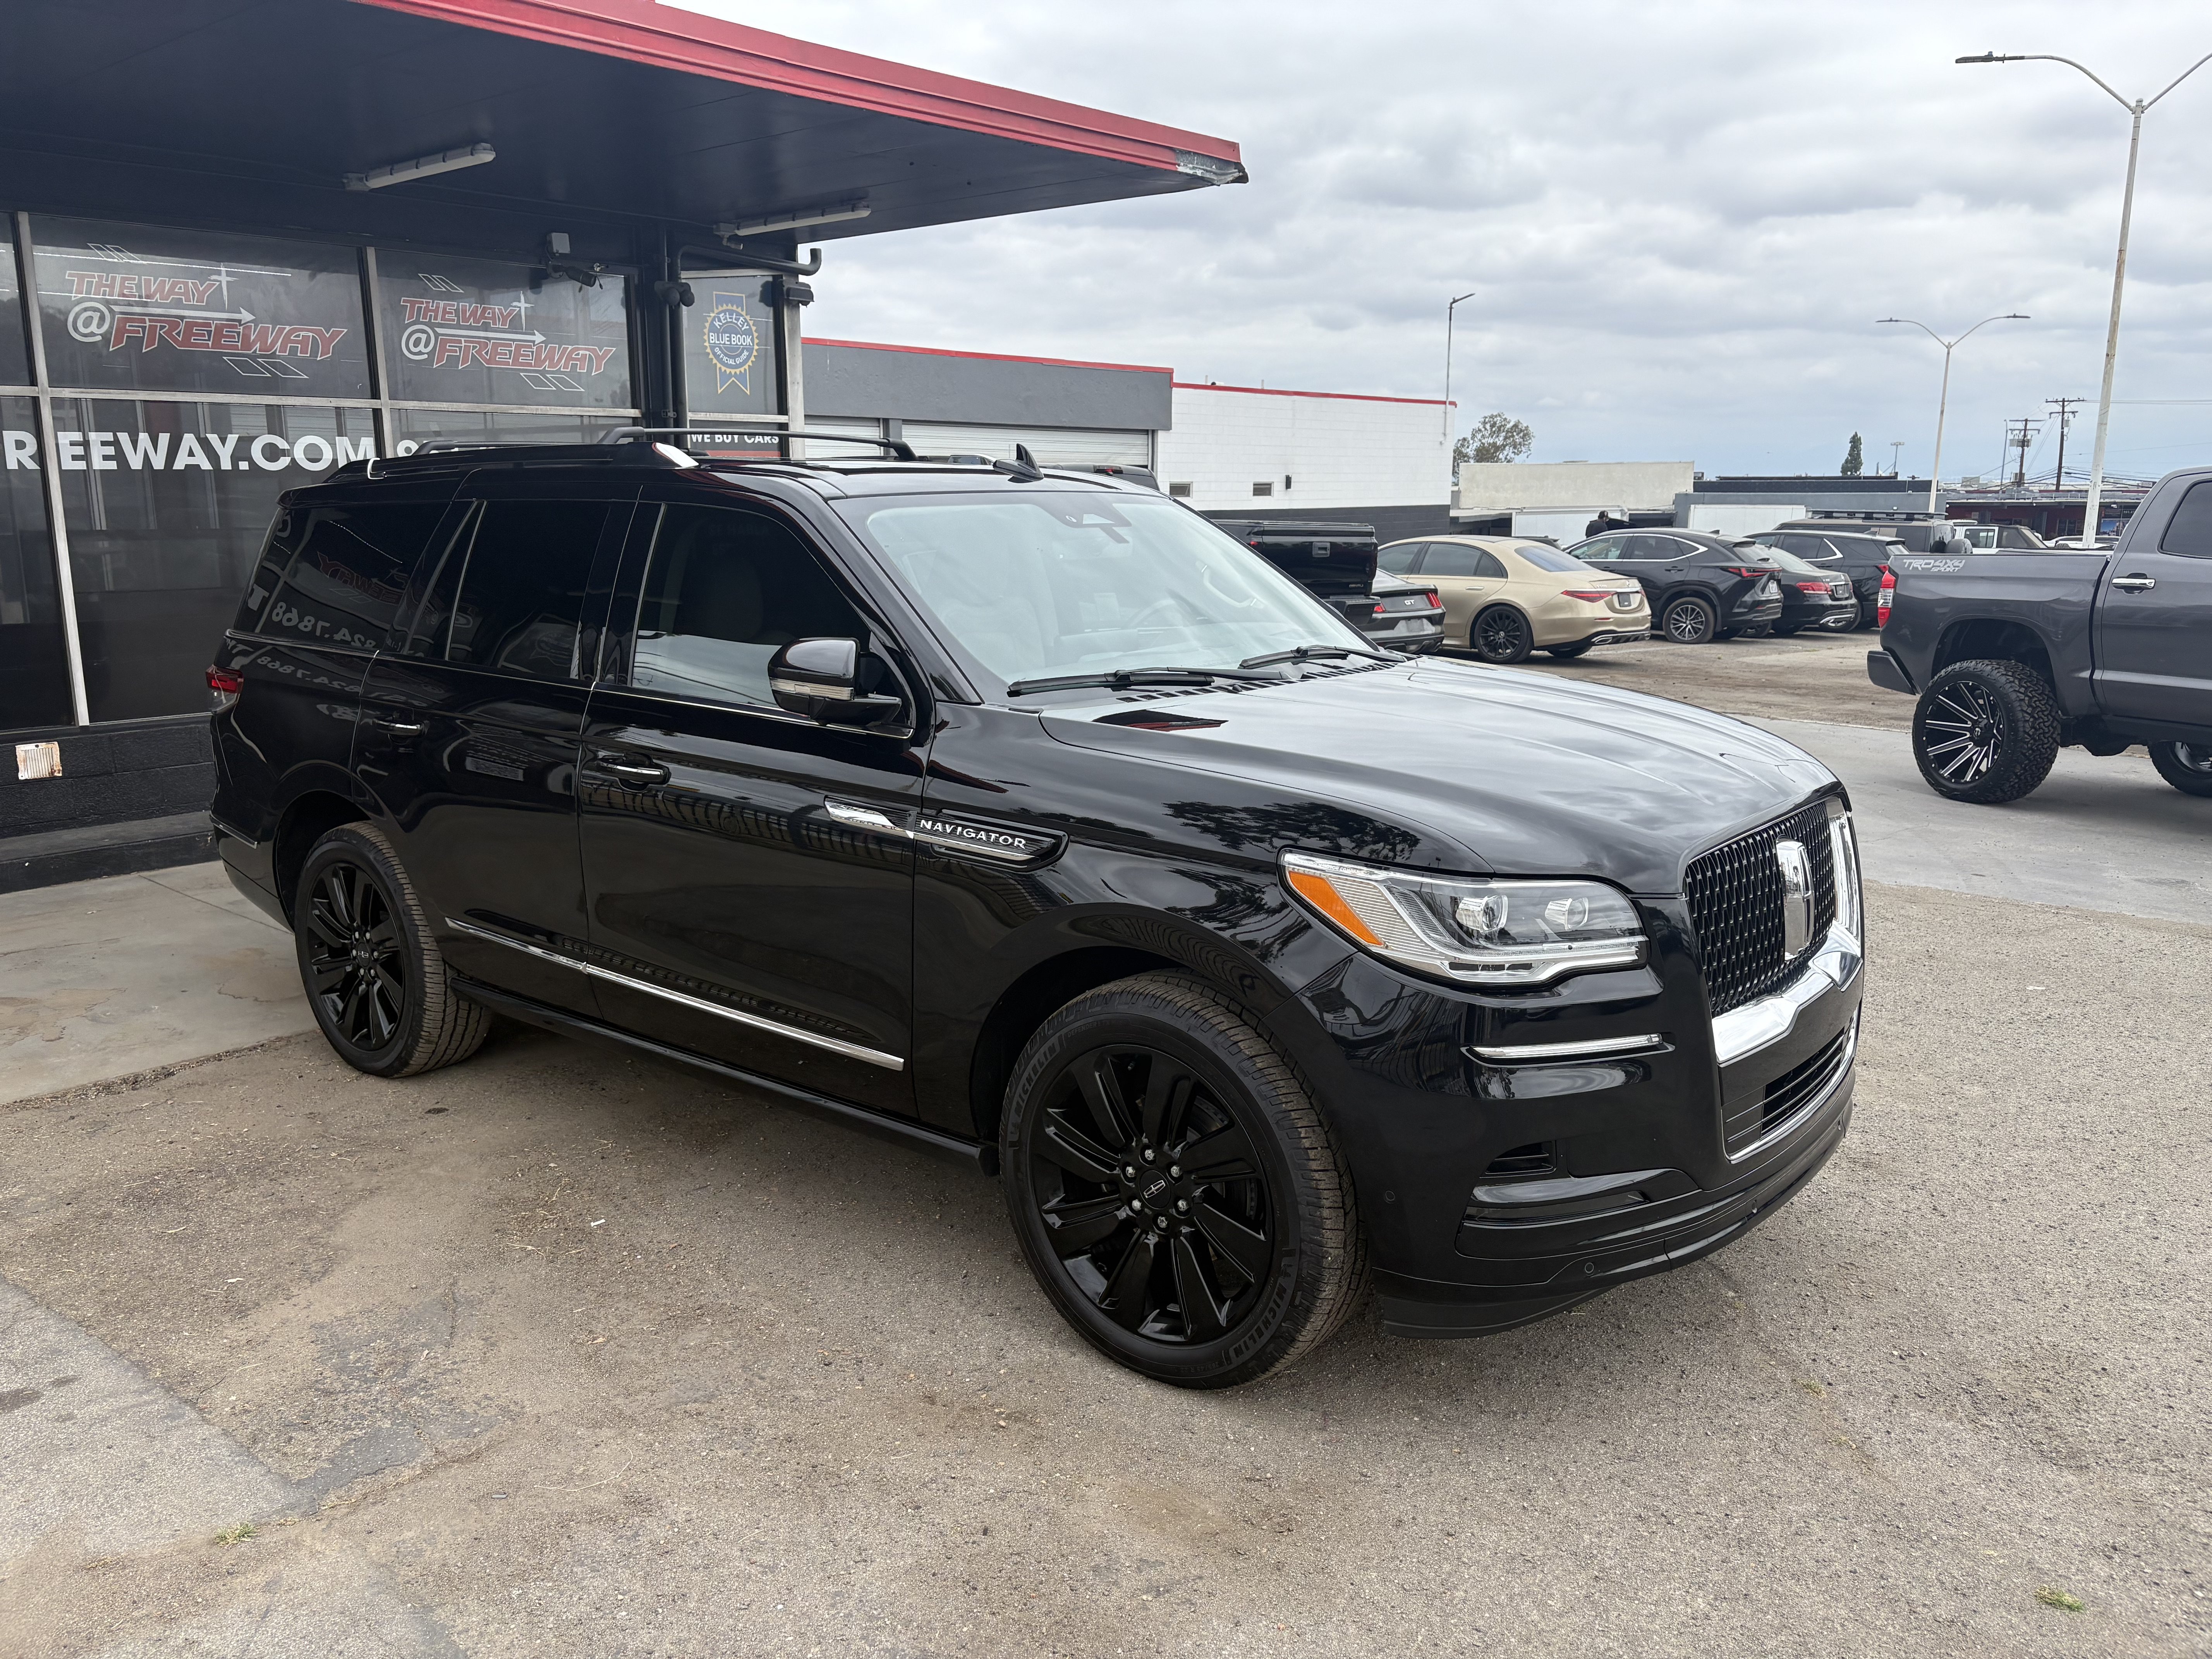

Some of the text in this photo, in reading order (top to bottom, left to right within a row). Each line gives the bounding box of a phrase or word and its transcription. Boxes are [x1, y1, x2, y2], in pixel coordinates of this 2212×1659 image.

[65, 271, 220, 305] THE WAY
[400, 297, 520, 328] THE WAY
[713, 312, 749, 331] KELLEY
[709, 333, 752, 346] BLUE BOOK
[714, 347, 749, 365] OFFICIAL GUIDE
[691, 434, 779, 443] WE BUY CARS
[1903, 559, 1934, 570] TRD
[920, 819, 1027, 849] NAVIGATOR
[1068, 1022, 1097, 1038] DEFENDER
[1014, 1042, 1057, 1118] MICHELIN
[1233, 1282, 1287, 1358] MICHELIN
